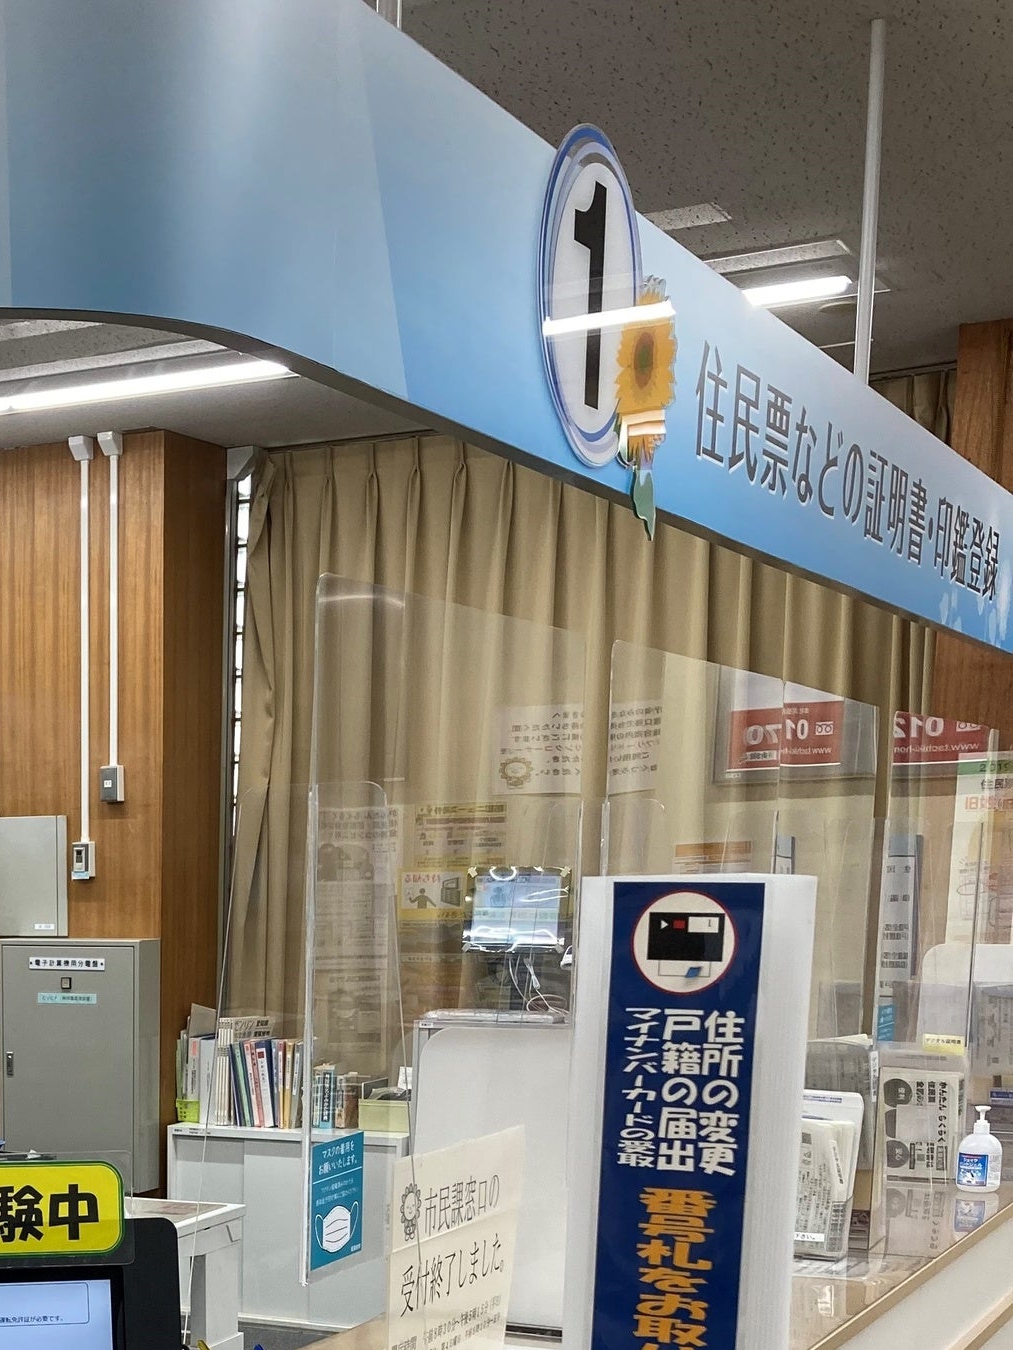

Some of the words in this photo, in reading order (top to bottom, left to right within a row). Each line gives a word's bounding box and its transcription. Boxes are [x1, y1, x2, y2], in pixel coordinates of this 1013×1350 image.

[574, 181, 607, 409] 1
[695, 340, 1000, 601] 住民票などの証明書・印鑑登録
[617, 1008, 662, 1168] マイナンバーカードの受取
[658, 1008, 705, 1173] 戸籍の届出
[697, 1009, 746, 1176] 住所の変更
[400, 1233, 504, 1317] 受付終了しました。
[424, 1174, 500, 1236] 市民課窓口の
